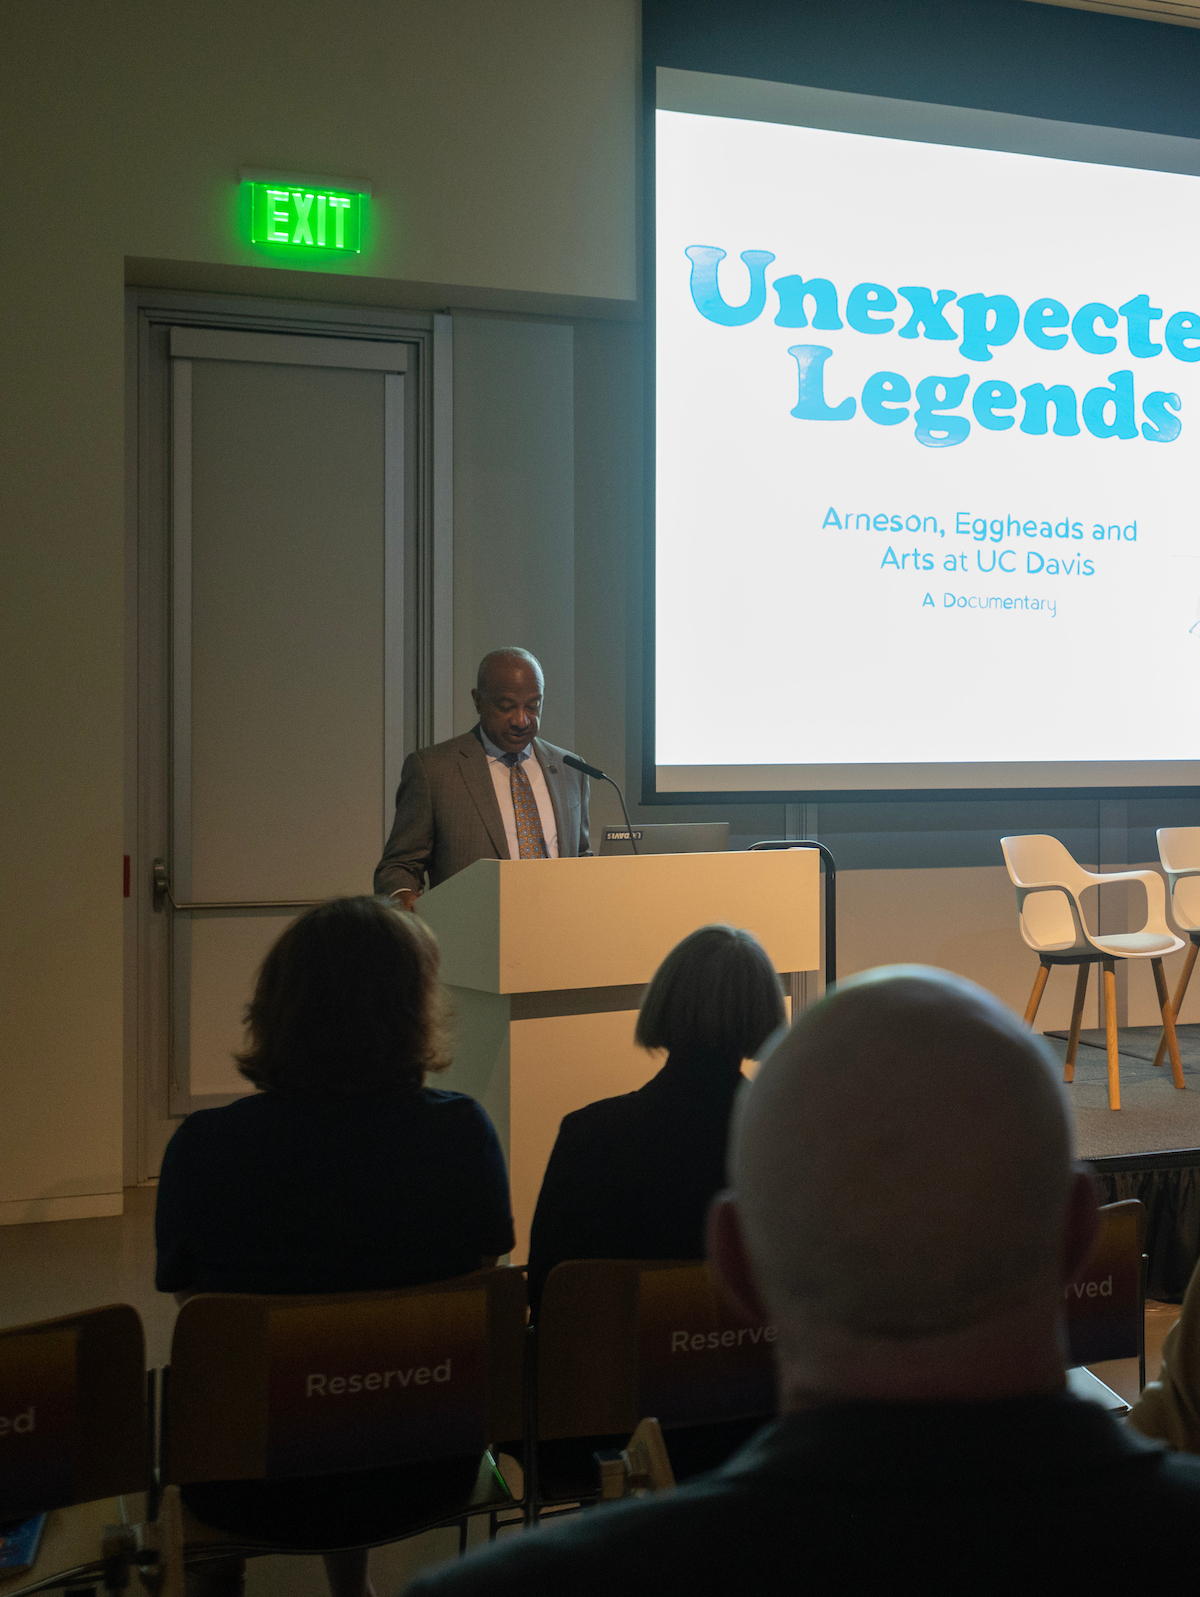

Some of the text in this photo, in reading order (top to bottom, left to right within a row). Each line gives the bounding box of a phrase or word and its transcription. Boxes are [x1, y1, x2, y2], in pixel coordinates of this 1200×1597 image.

[266, 190, 350, 248] EXIT
[787, 344, 1182, 448] Legends
[822, 506, 1137, 543] Arneson, Eggheads and
[880, 546, 1096, 577] Arts at UC Davis
[922, 592, 1058, 618] A Documentary
[1064, 1274, 1113, 1299] rved
[671, 1325, 779, 1354] Reserve
[306, 1357, 452, 1398] Reserved
